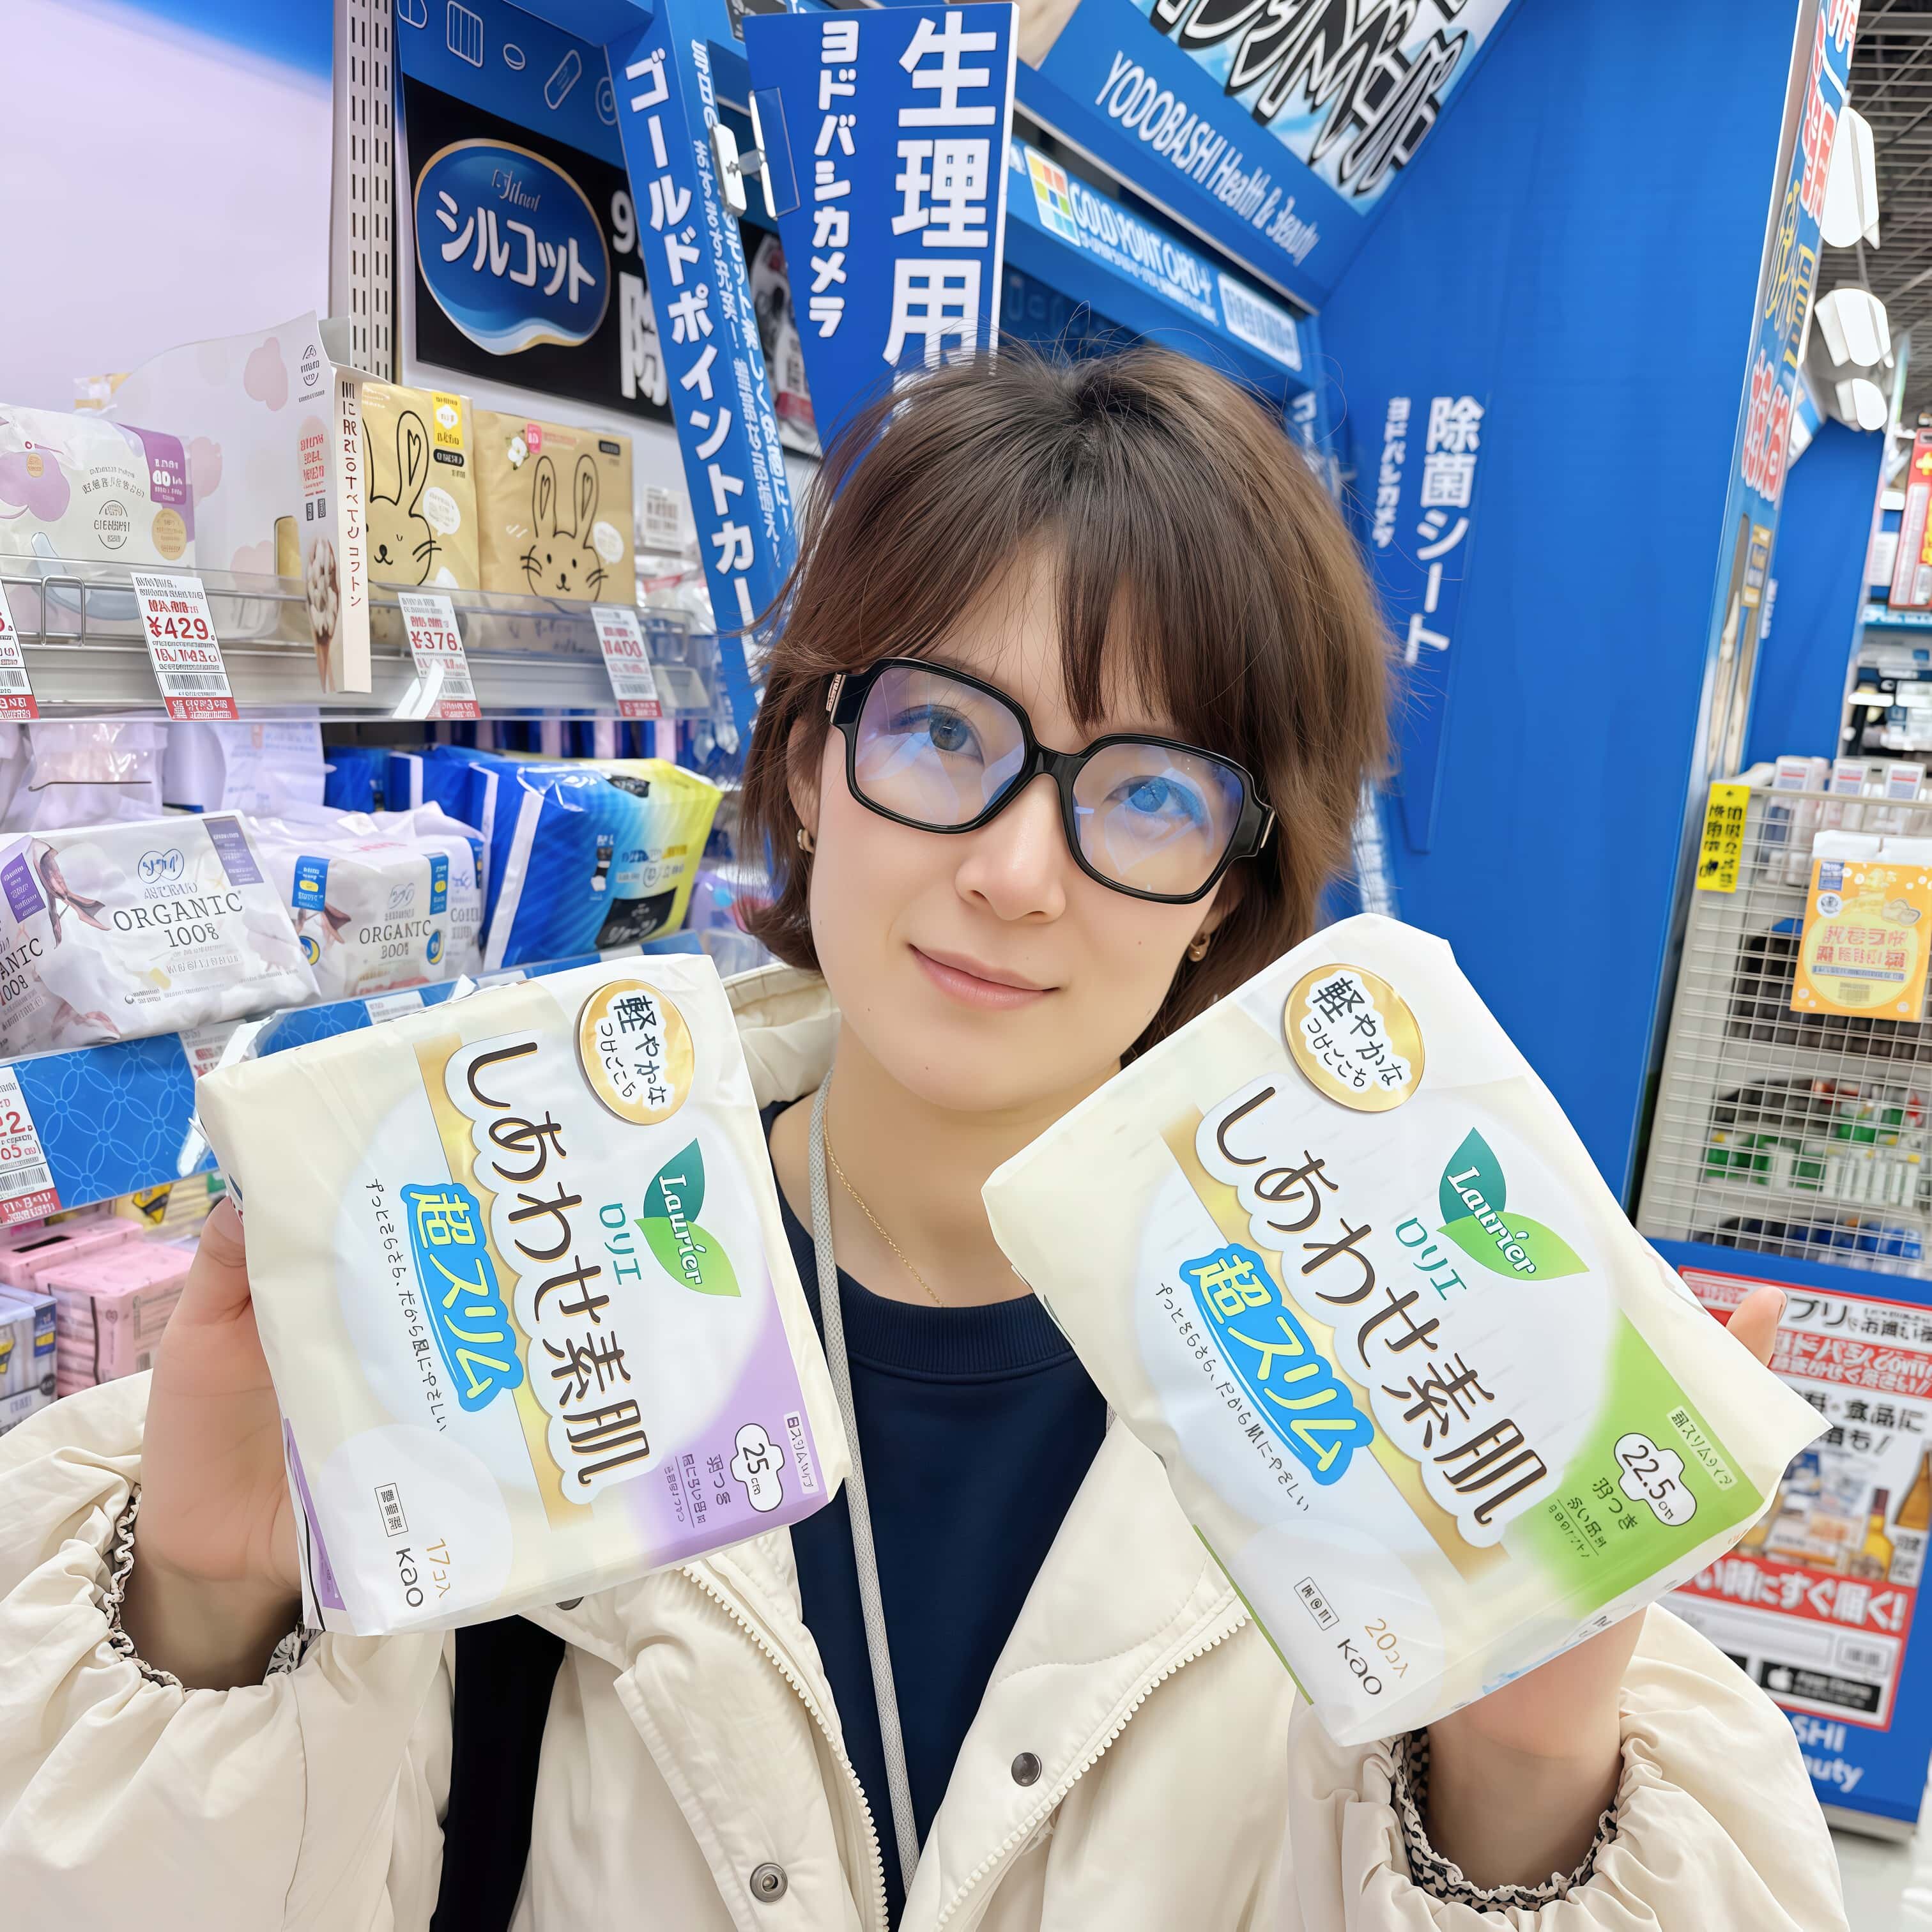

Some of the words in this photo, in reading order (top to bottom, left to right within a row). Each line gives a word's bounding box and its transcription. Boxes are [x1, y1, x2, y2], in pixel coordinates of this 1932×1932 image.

[809, 20, 859, 338] ヨドバシカメラ
[1094, 50, 1228, 184] YODOBASHI
[1206, 146, 1271, 221] Health
[435, 190, 596, 305] シルコット
[882, 10, 997, 415] 生理用
[625, 47, 776, 709] ゴールドポイントカード
[1406, 395, 1485, 667] 除菌シート
[112, 892, 243, 931] ORGANIC
[613, 994, 668, 1107] 軽やかな
[1312, 977, 1403, 1087] 軽やかな
[467, 1041, 650, 1486] しあわせ素肌
[598, 1202, 642, 1285] ロリエ
[658, 1172, 707, 1286] Laurier
[1395, 1218, 1467, 1301] ロリエ
[1446, 1166, 1536, 1275] Laurier
[411, 1190, 511, 1400] 超スリム
[1190, 1252, 1358, 1472] 超スリム
[1216, 1085, 1547, 1526] しあわせ素肌
[1692, 1558, 1908, 1632] い時にすぐ届く!
